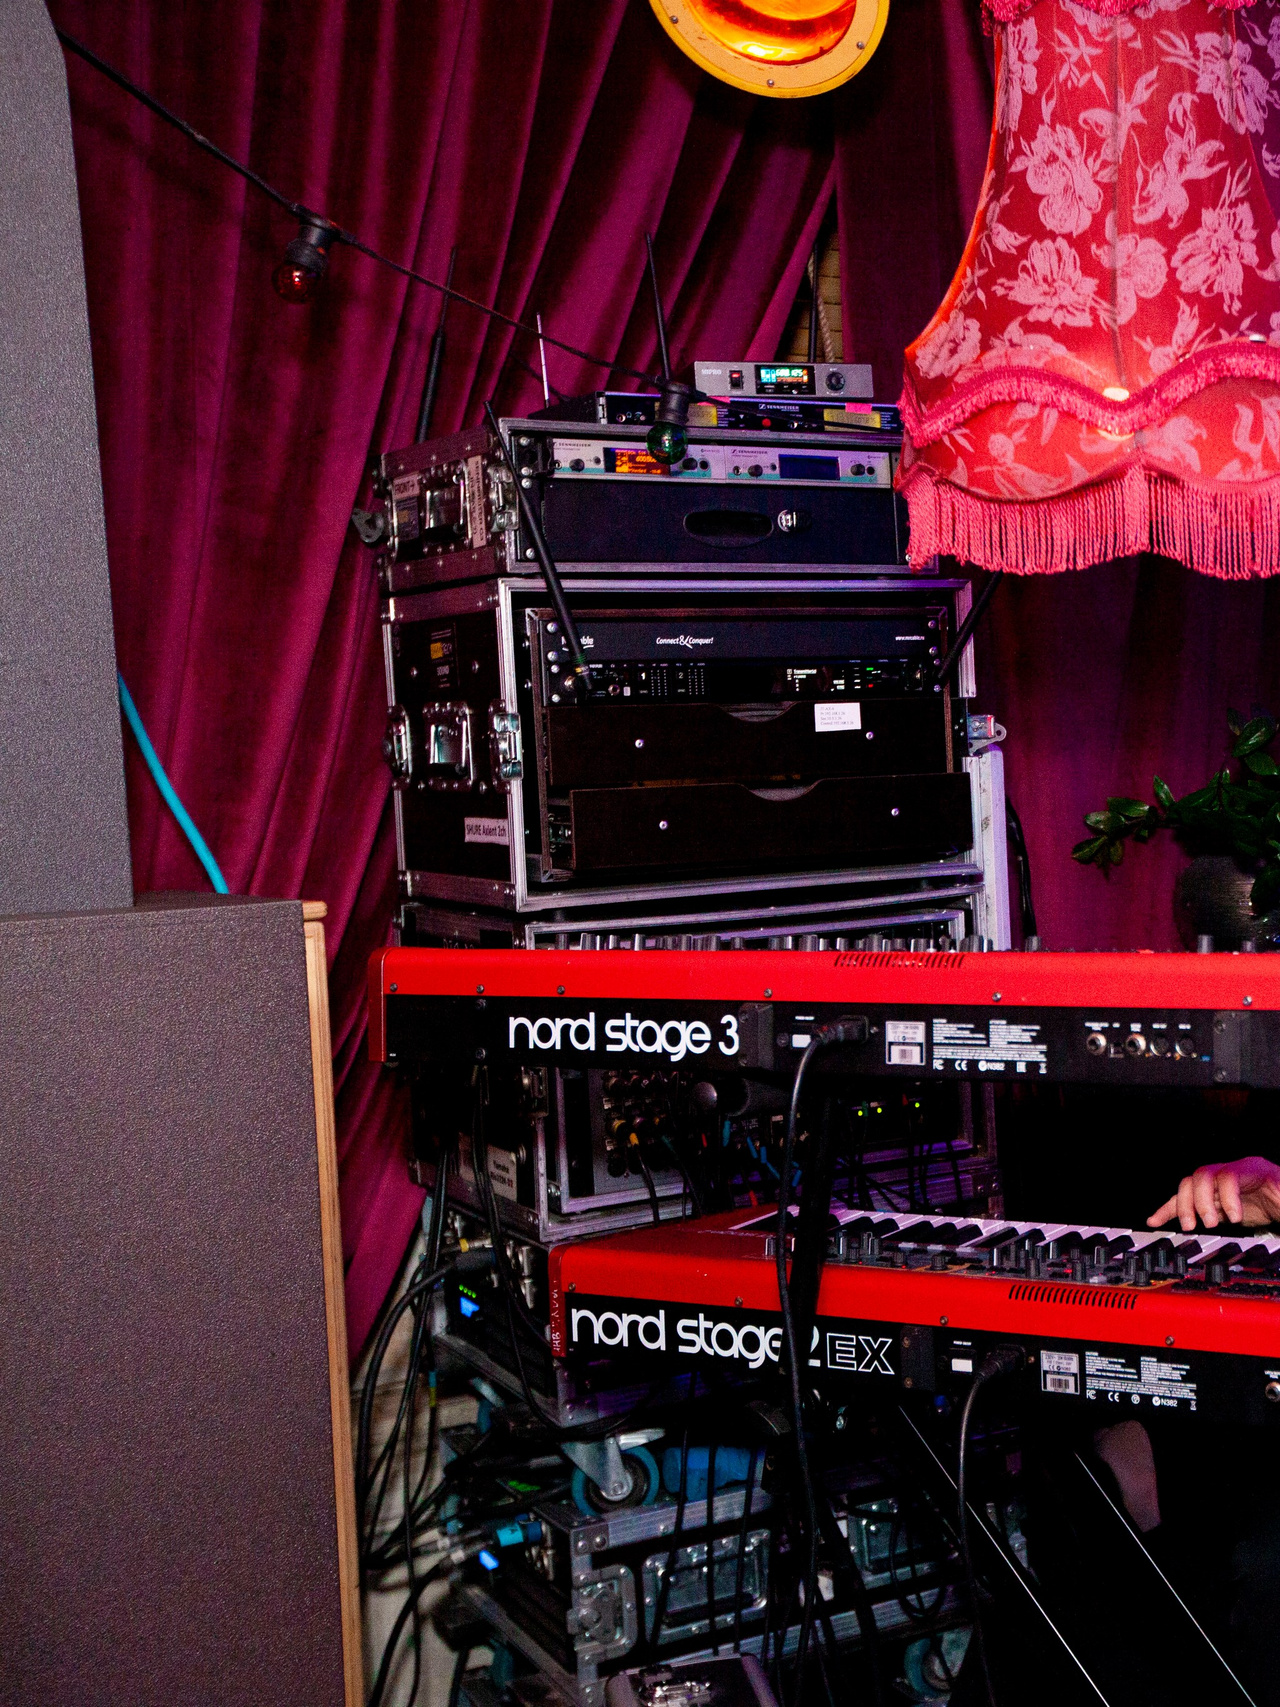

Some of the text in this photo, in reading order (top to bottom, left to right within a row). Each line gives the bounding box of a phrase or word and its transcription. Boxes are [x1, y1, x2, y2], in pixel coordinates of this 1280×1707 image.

[509, 1012, 739, 1062] nord stage 3
[571, 1308, 666, 1351] nord
[677, 1312, 784, 1369] stage
[826, 1332, 895, 1375] EX
[1108, 1391, 1119, 1402] CE
[1160, 1399, 1178, 1407] N382
